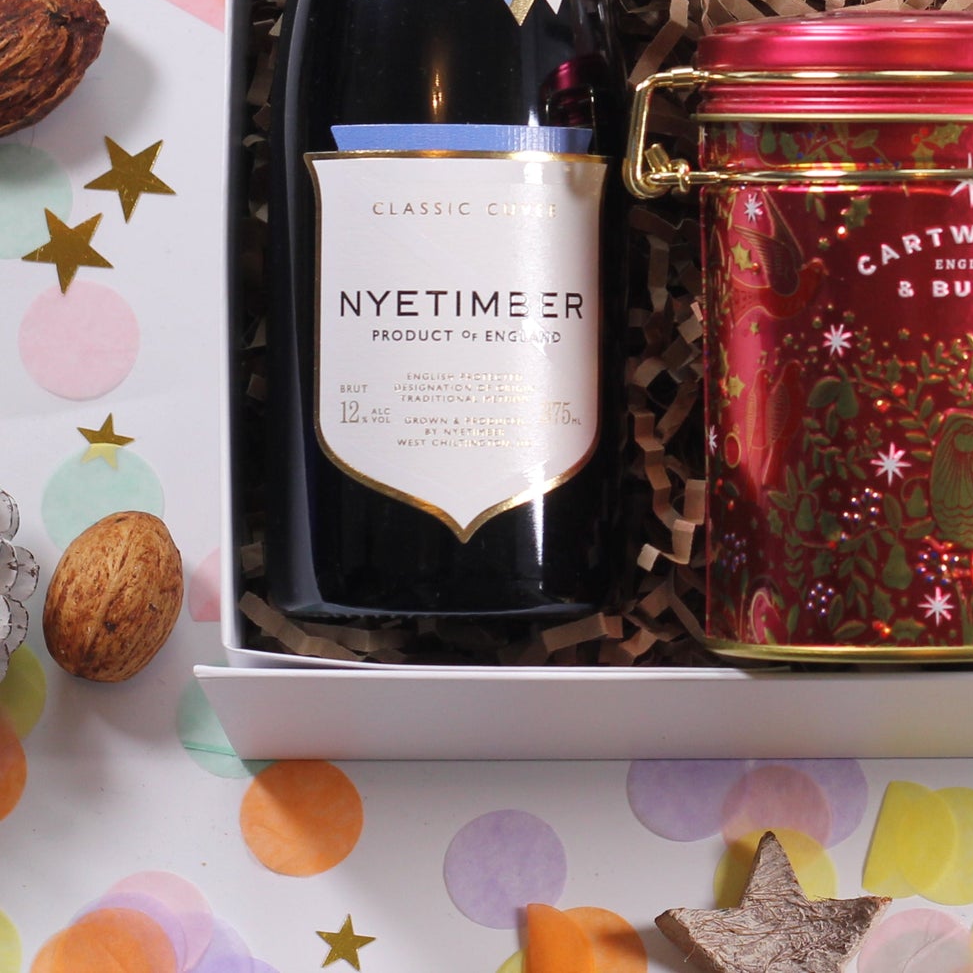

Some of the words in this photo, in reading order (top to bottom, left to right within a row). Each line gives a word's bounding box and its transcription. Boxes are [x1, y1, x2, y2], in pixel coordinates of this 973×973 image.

[372, 202, 472, 216] CLASSIC
[897, 280, 915, 298] &
[339, 289, 584, 319] NYETIMBER
[371, 329, 454, 342] PRODUCT
[485, 330, 562, 343] ENGLAND
[407, 372, 455, 381] ENGLISH
[340, 384, 368, 394] BRUT
[393, 383, 472, 392] DESIGNATION
[400, 394, 478, 403] TRADITIONAL
[371, 407, 391, 415] ALC
[371, 416, 391, 424] VOL
[404, 416, 448, 425] GROWN
[425, 428, 437, 436] BY
[397, 438, 426, 447] WEST
